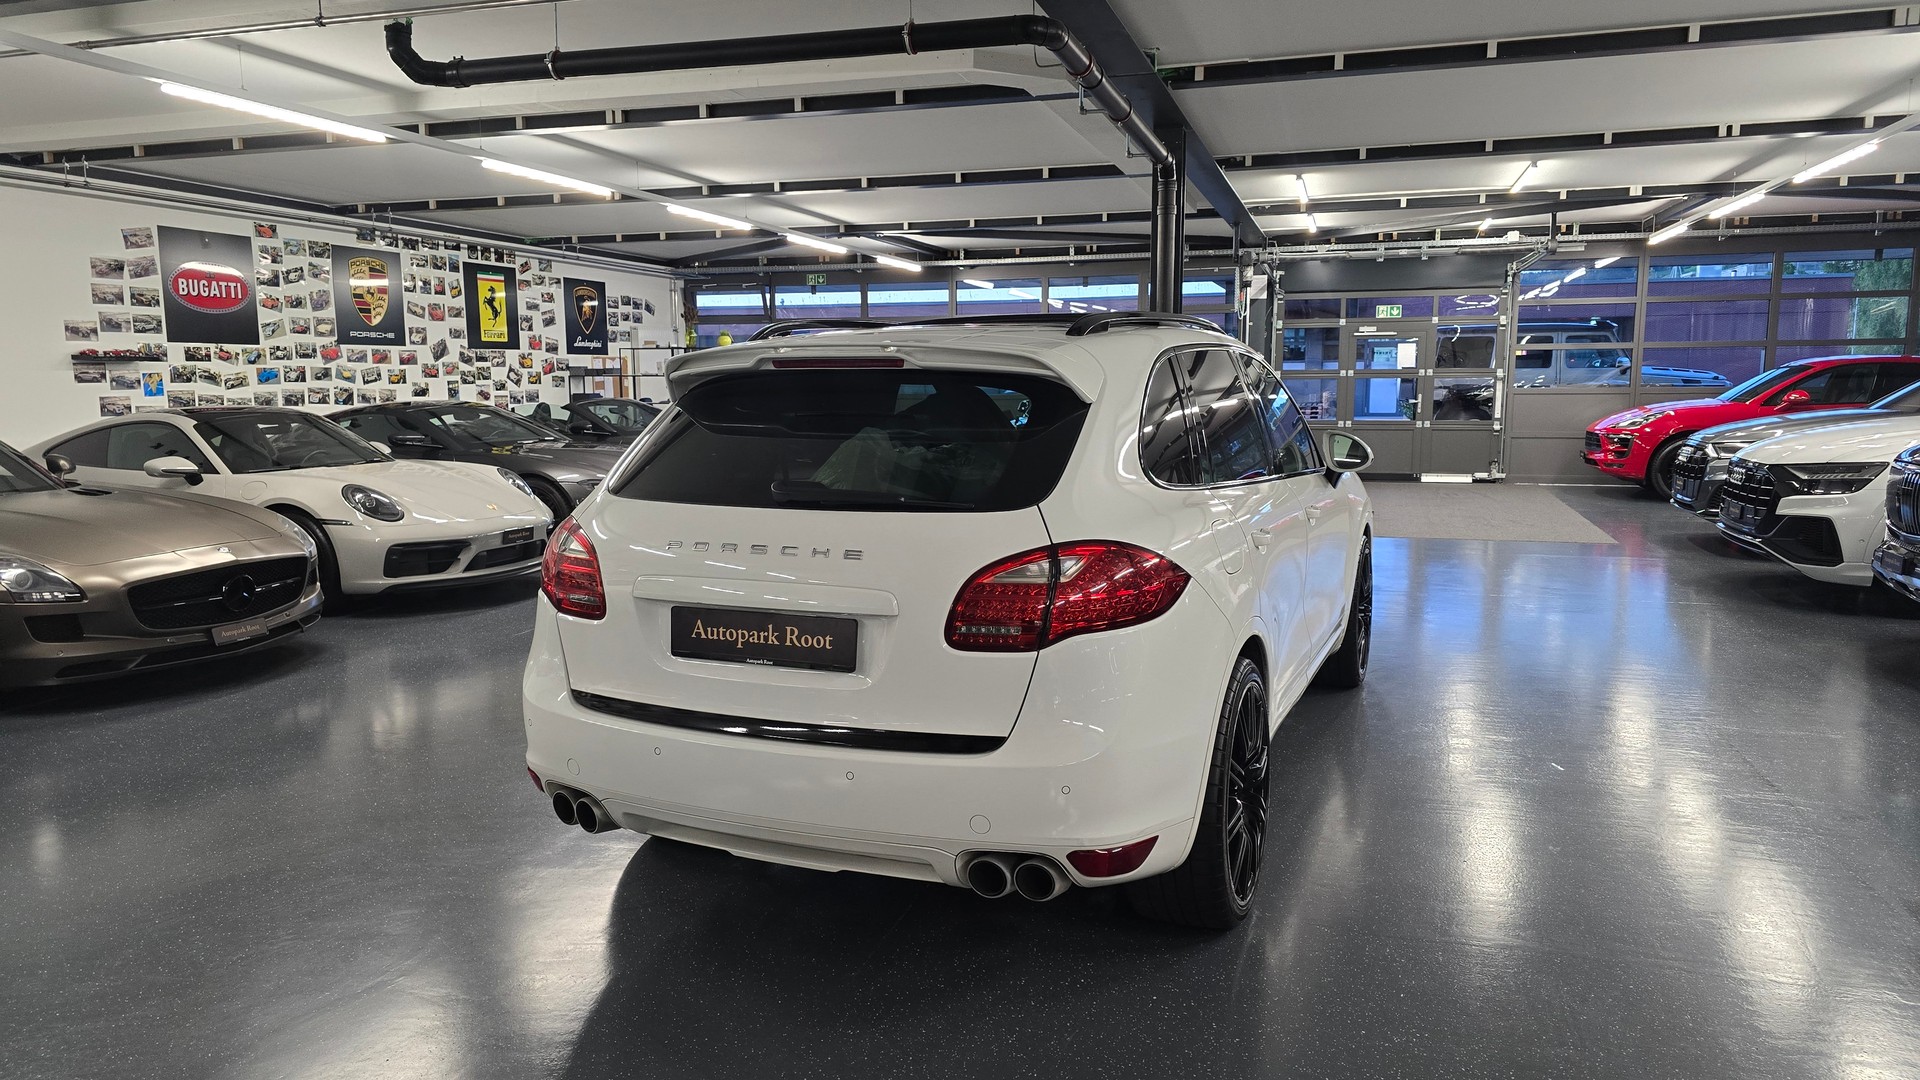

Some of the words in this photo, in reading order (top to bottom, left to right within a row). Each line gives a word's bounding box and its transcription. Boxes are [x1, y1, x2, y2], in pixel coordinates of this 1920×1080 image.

[350, 259, 386, 271] PORSCHE
[178, 278, 242, 299] BUGATTI
[349, 331, 395, 339] PORSCHE
[484, 329, 506, 339] Ferrari
[574, 336, 602, 349] Lamborghini
[666, 540, 864, 561] PORSCHE
[222, 627, 246, 637] Autopark
[691, 618, 780, 649] Autopark
[785, 626, 833, 650] Root
